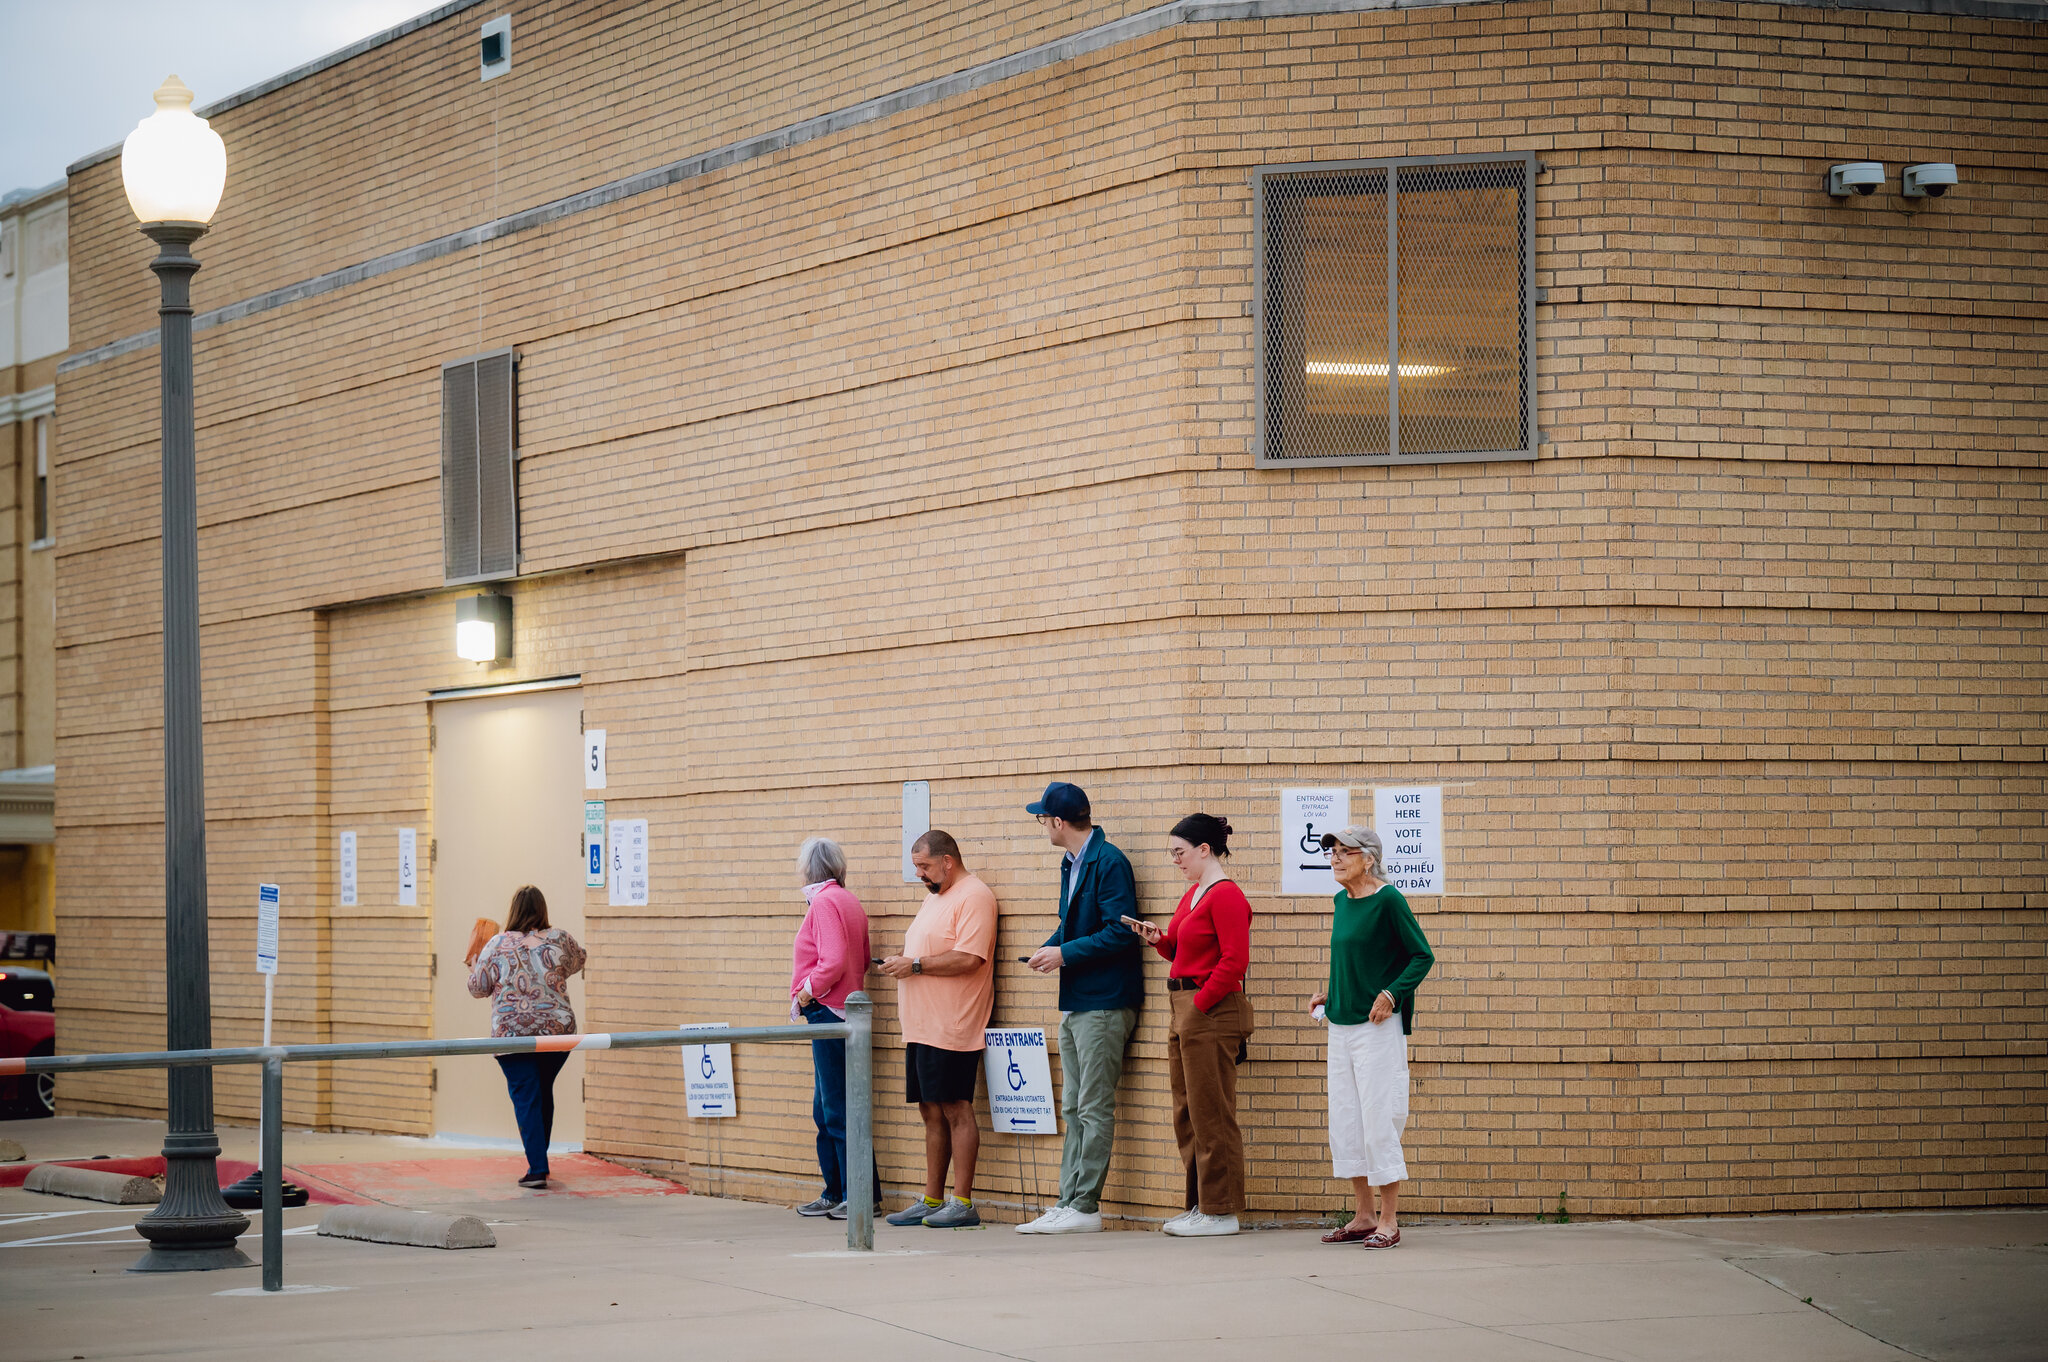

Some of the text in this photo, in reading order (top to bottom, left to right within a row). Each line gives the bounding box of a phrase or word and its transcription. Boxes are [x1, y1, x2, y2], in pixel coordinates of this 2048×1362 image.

[591, 746, 598, 771] 5
[1394, 794, 1421, 803] VOTE
[1395, 810, 1421, 818] HERE
[1395, 829, 1422, 838] VOTE
[1395, 843, 1422, 855] AQUÍ
[1404, 860, 1434, 873] PHIẾU
[1410, 876, 1431, 888] ĐÂY
[985, 1032, 1043, 1046] OTER ENTRANCE
